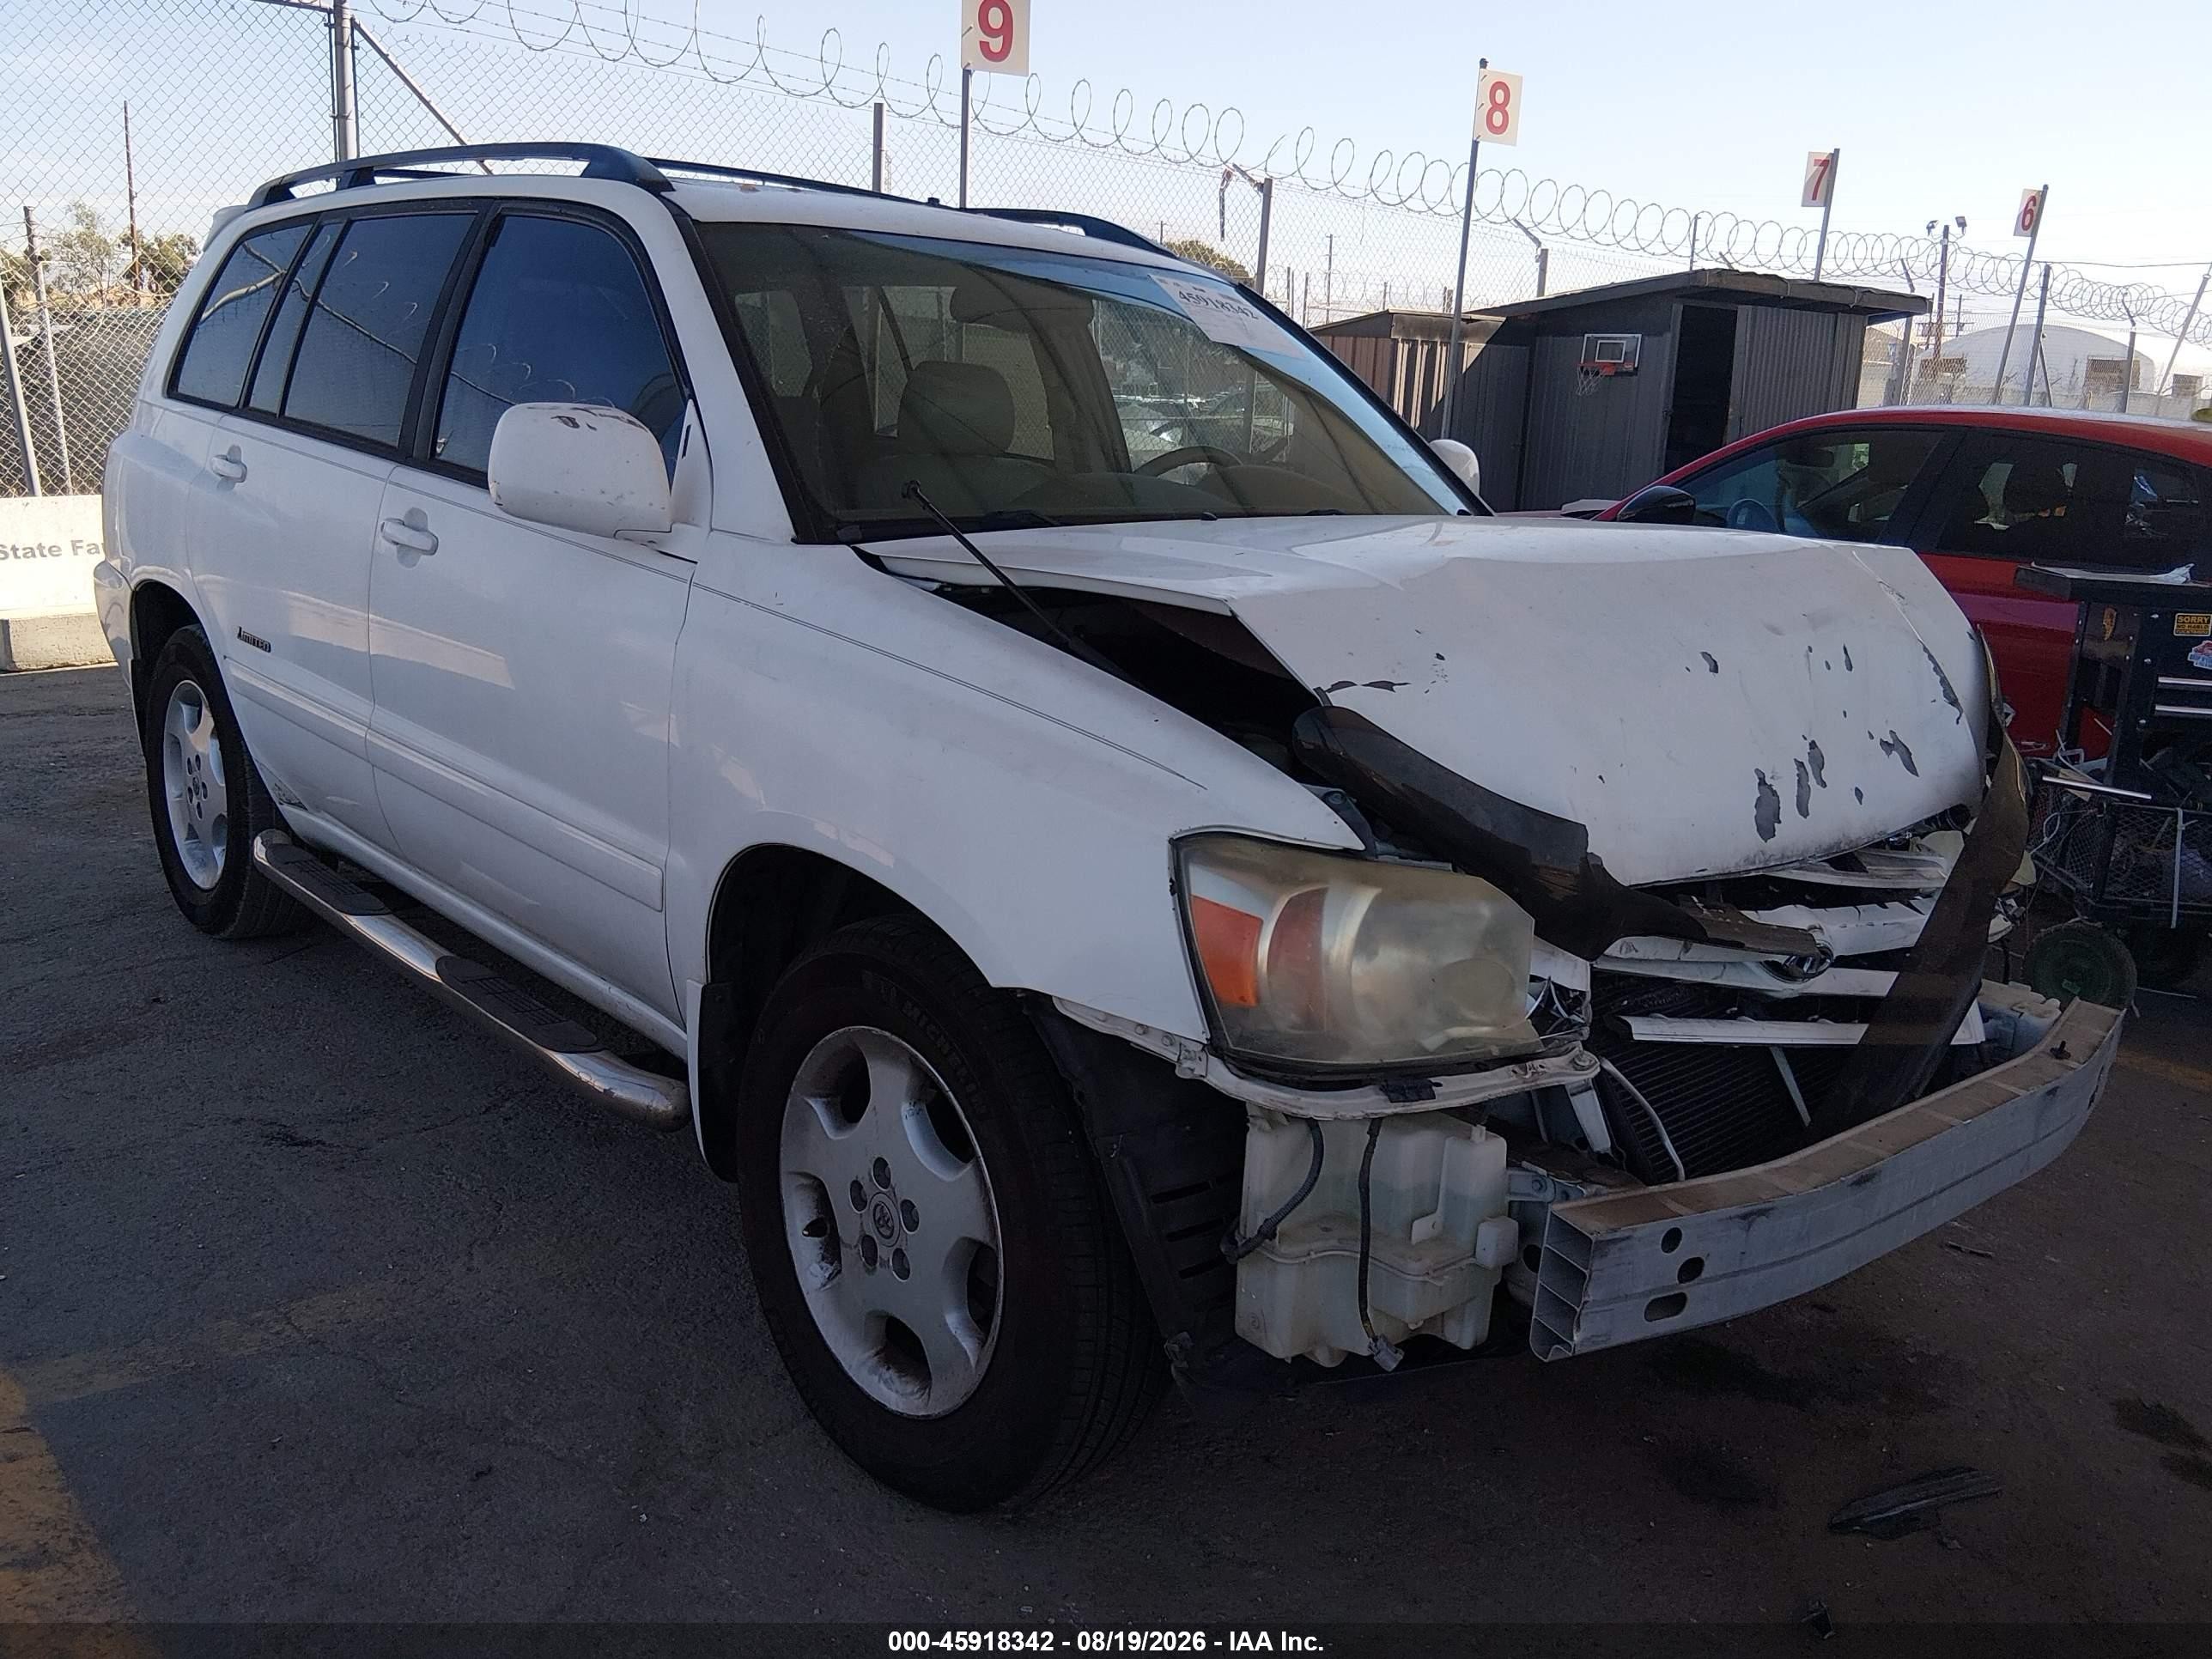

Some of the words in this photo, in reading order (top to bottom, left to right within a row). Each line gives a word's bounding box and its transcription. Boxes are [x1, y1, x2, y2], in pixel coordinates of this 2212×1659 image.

[978, 0, 1014, 63] 9
[1486, 81, 1510, 135] 8
[1812, 159, 1830, 200] 7
[2021, 195, 2037, 231] 6
[1178, 290, 1259, 320] 45918342
[0, 543, 63, 561] State
[70, 539, 106, 556] Fa
